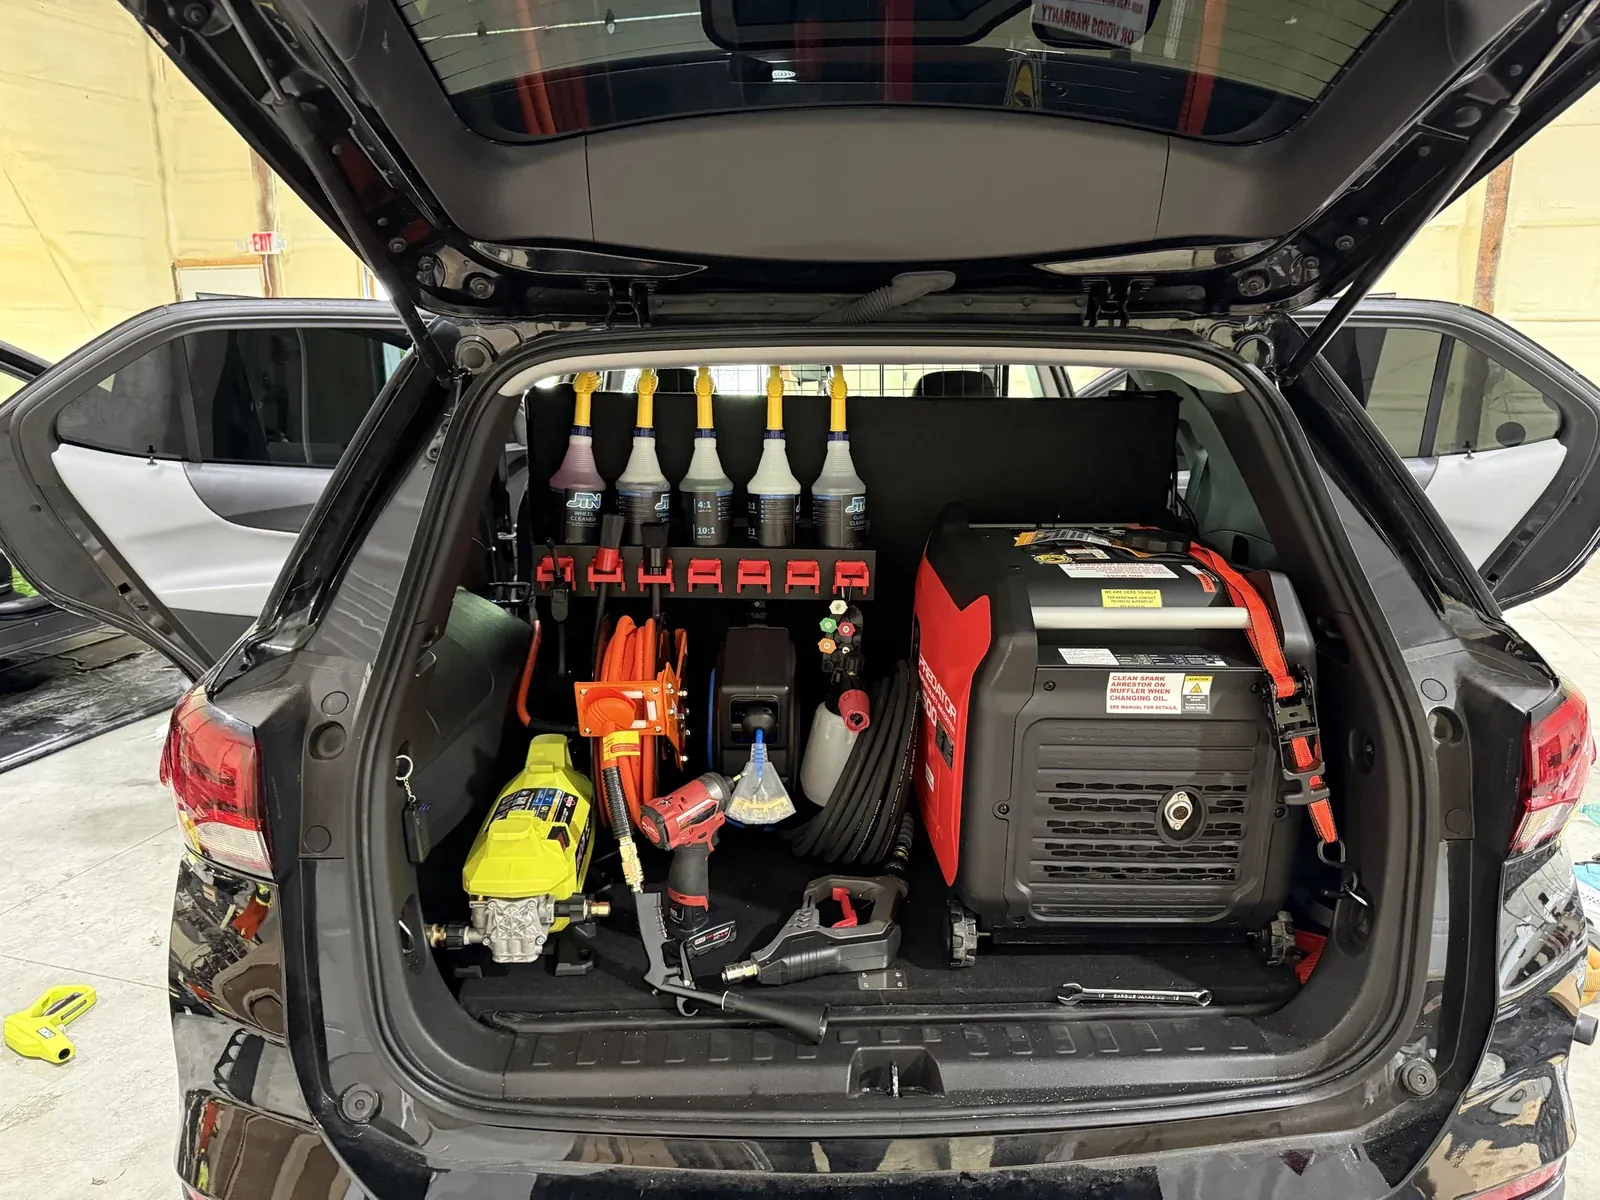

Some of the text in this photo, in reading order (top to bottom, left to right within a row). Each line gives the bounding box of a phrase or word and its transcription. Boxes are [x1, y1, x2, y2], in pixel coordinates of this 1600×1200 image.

[252, 233, 272, 252] EXIT
[566, 492, 602, 509] JTN
[697, 500, 712, 509] 4:1
[697, 526, 716, 535] 10:1
[919, 652, 957, 723] PREDATOR
